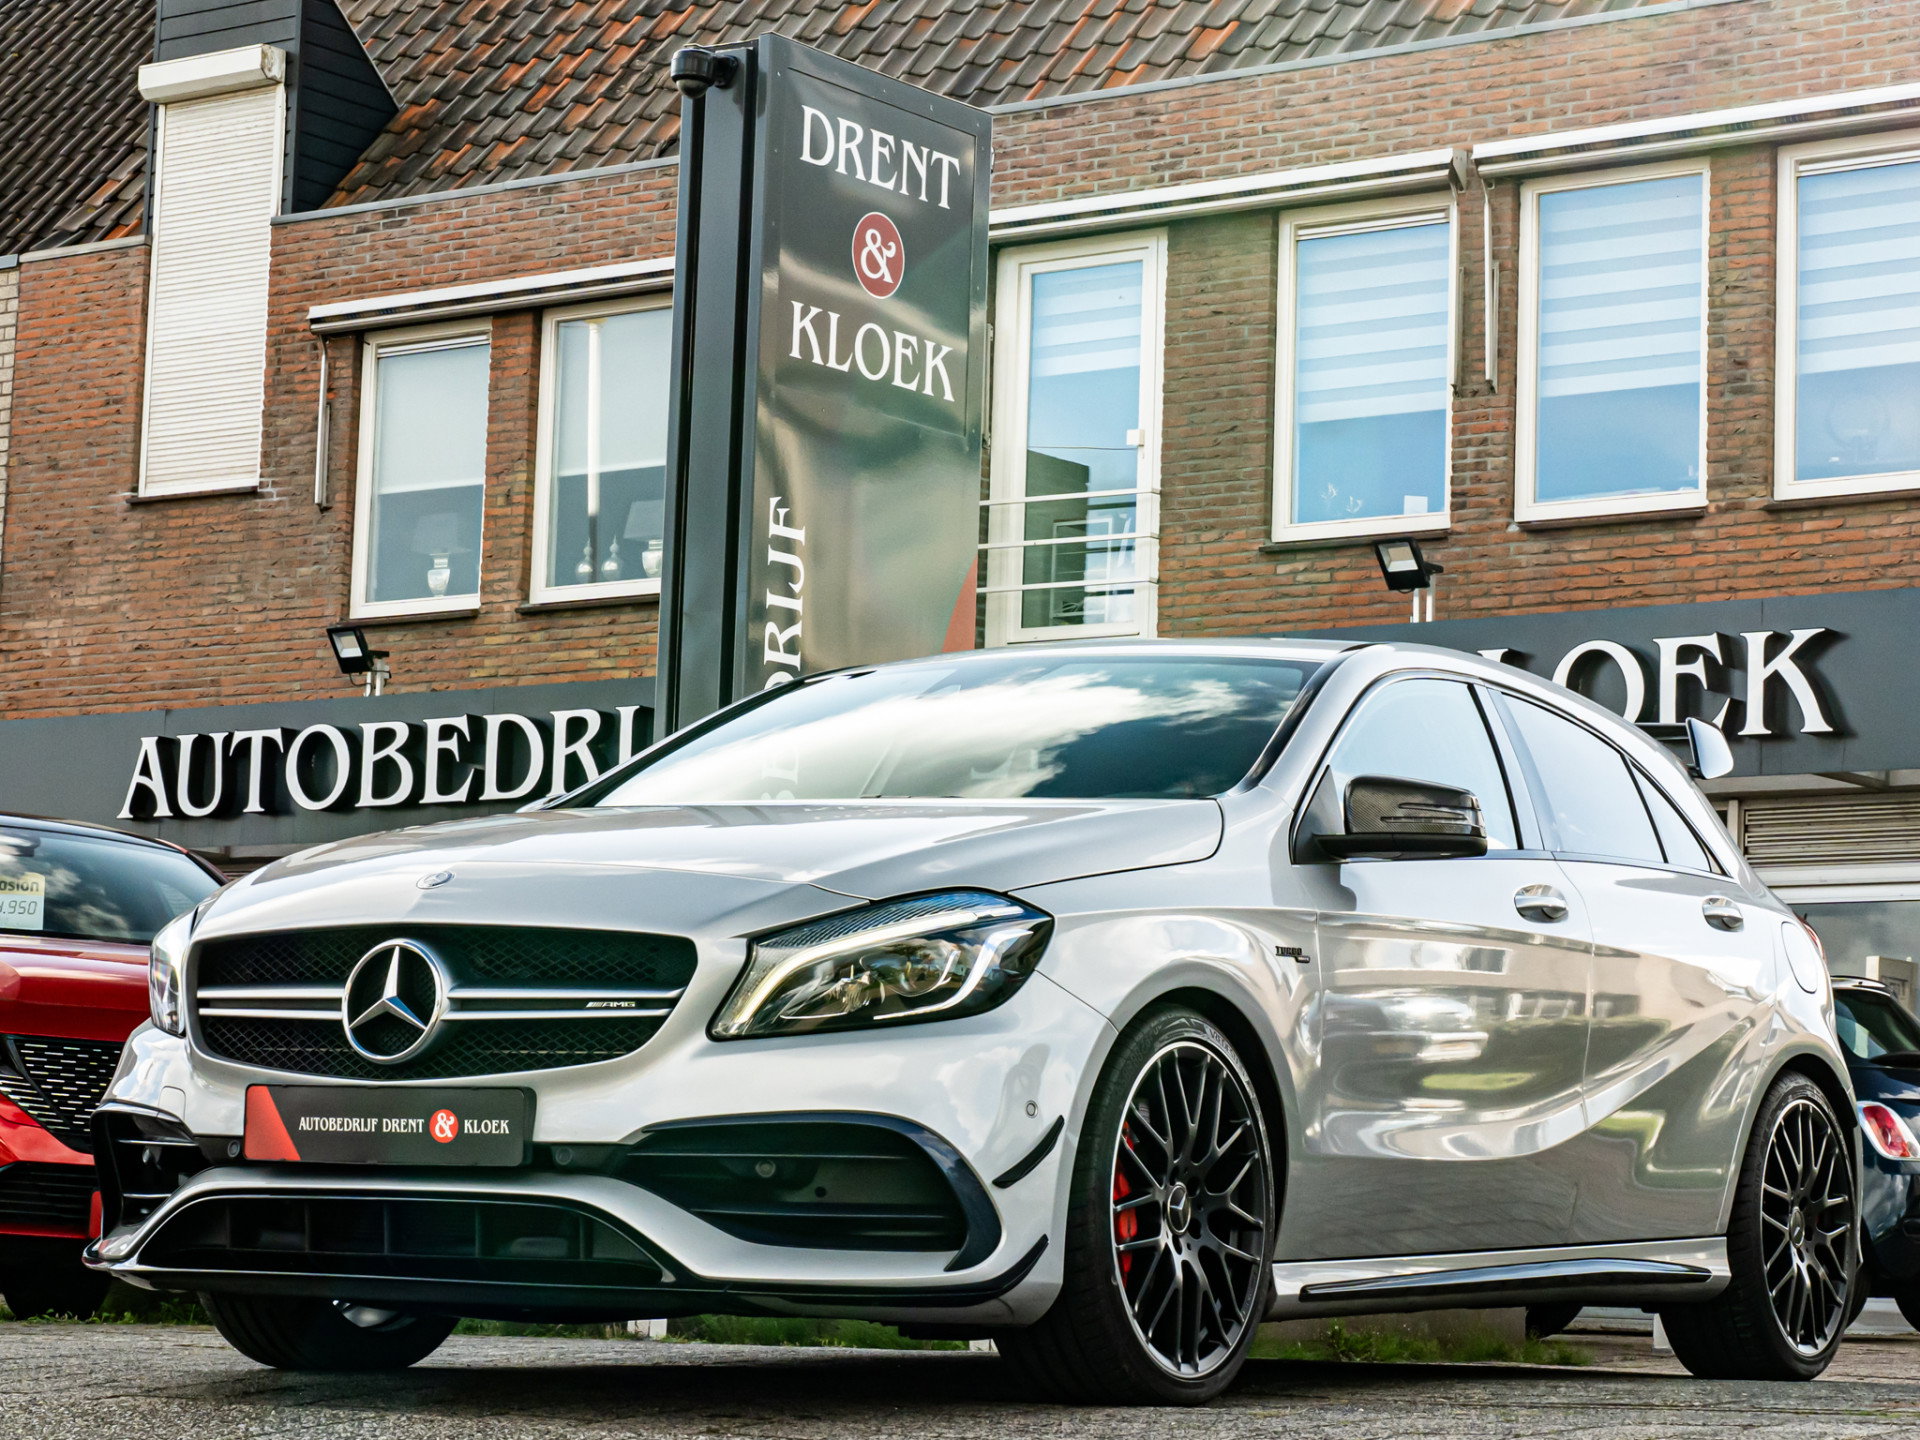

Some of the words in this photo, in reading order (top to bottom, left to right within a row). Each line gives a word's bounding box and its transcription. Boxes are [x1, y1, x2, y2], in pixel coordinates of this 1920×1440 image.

[800, 104, 961, 210] DRENT
[860, 228, 897, 284] &
[789, 300, 955, 402] KLOEK
[1477, 628, 1834, 736] OEK
[299, 1116, 379, 1132] AUTOBEDRIJF
[382, 1118, 425, 1133] DRENT
[434, 1112, 455, 1138] &
[463, 1118, 510, 1134] KLOEK
